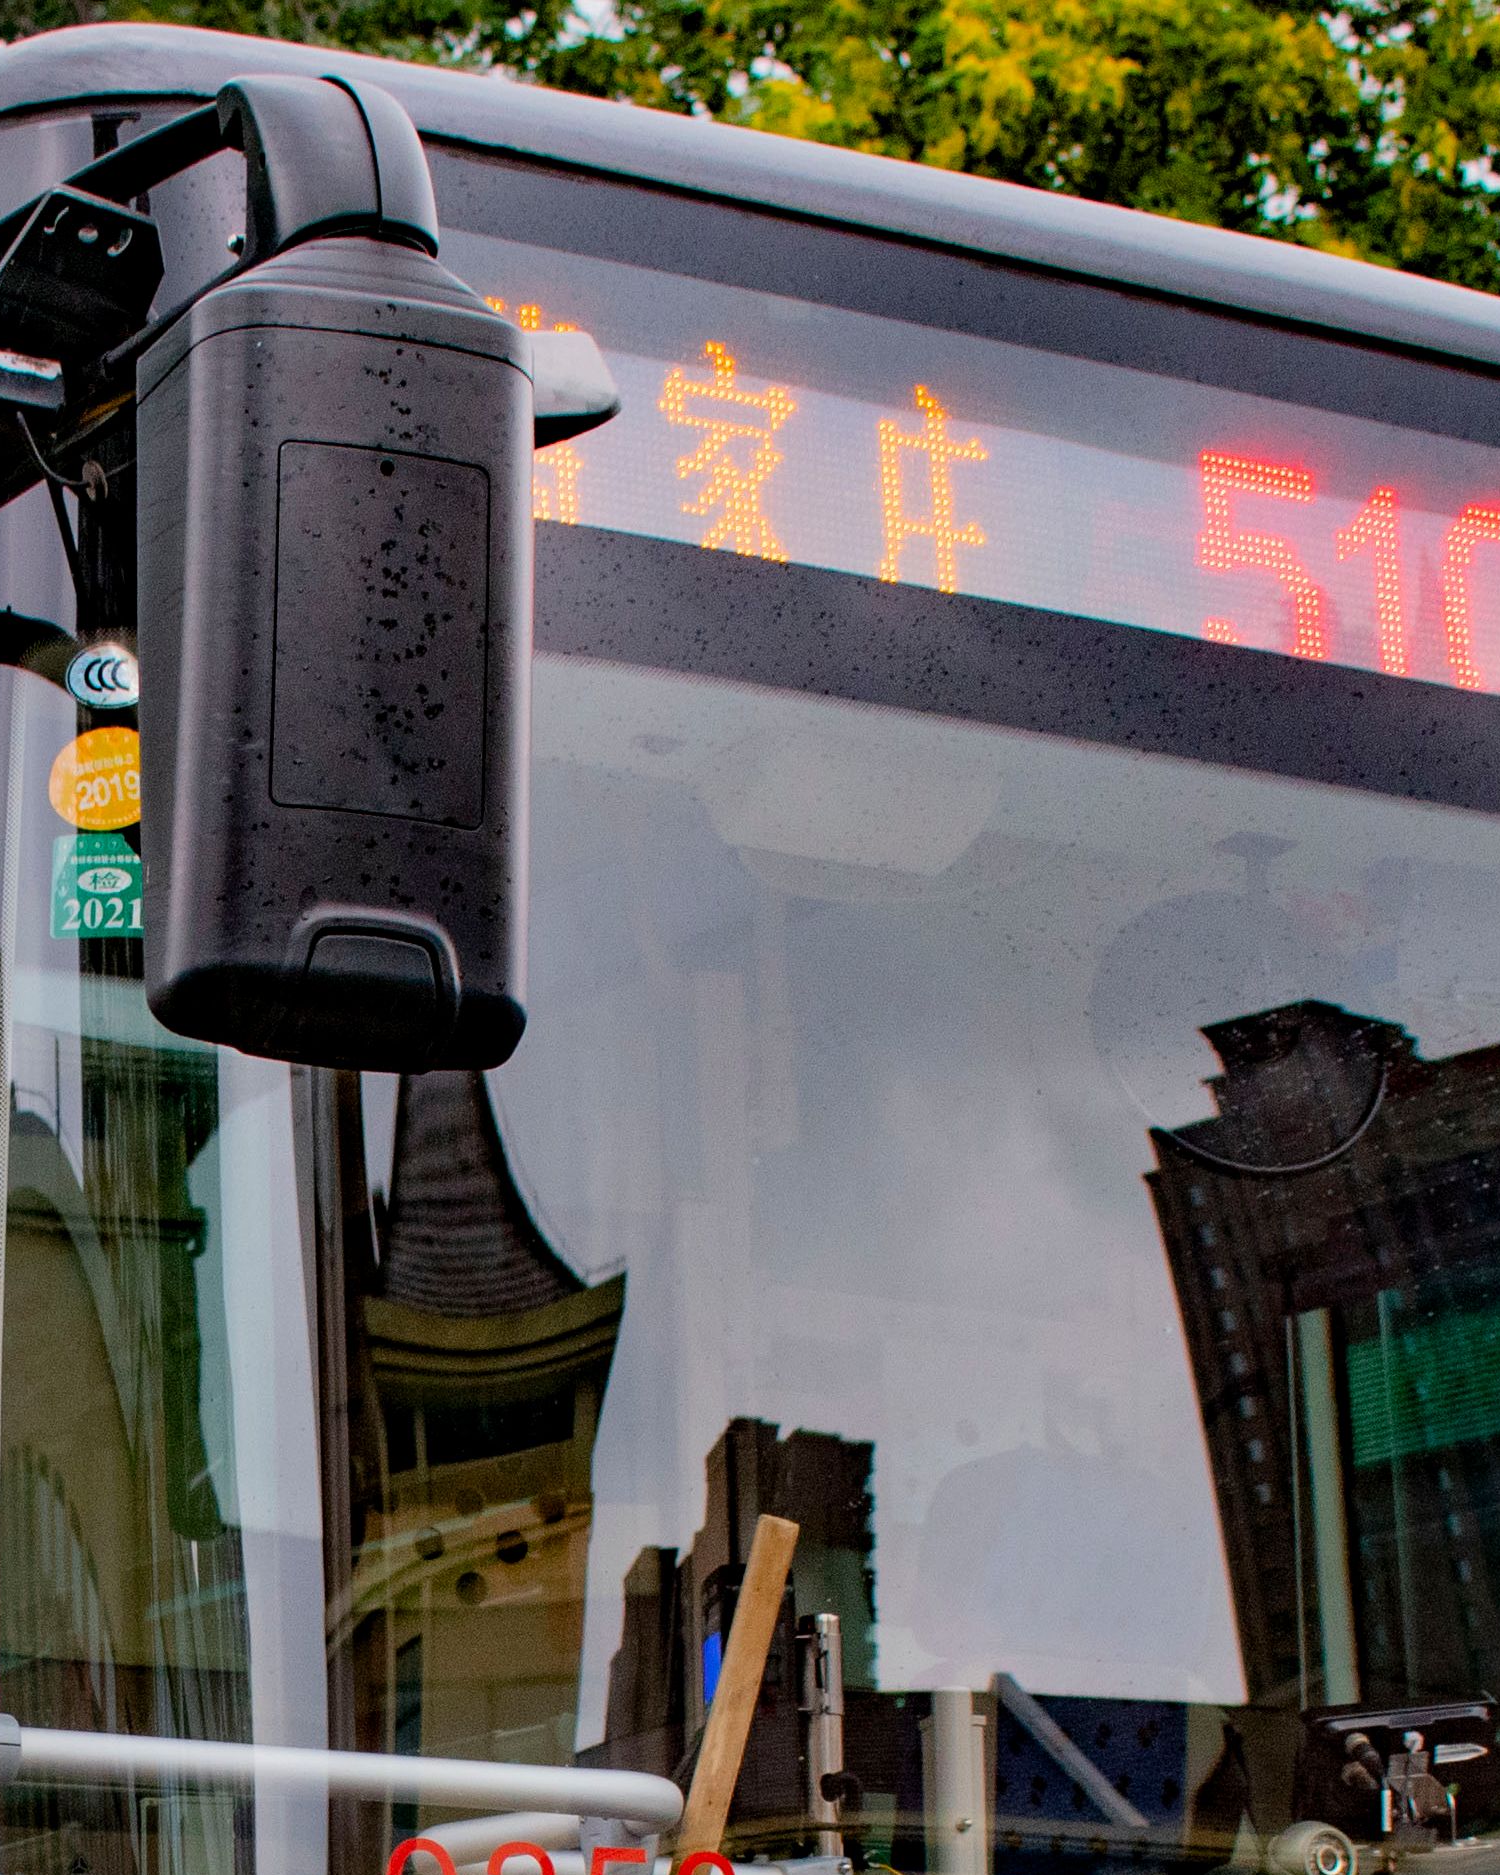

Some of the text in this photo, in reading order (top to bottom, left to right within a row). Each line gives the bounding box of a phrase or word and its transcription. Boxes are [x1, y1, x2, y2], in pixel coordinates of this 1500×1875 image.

[485, 295, 990, 594] 家庄
[76, 769, 140, 811] 2019
[90, 871, 120, 890] 检
[61, 897, 144, 930] 2021
